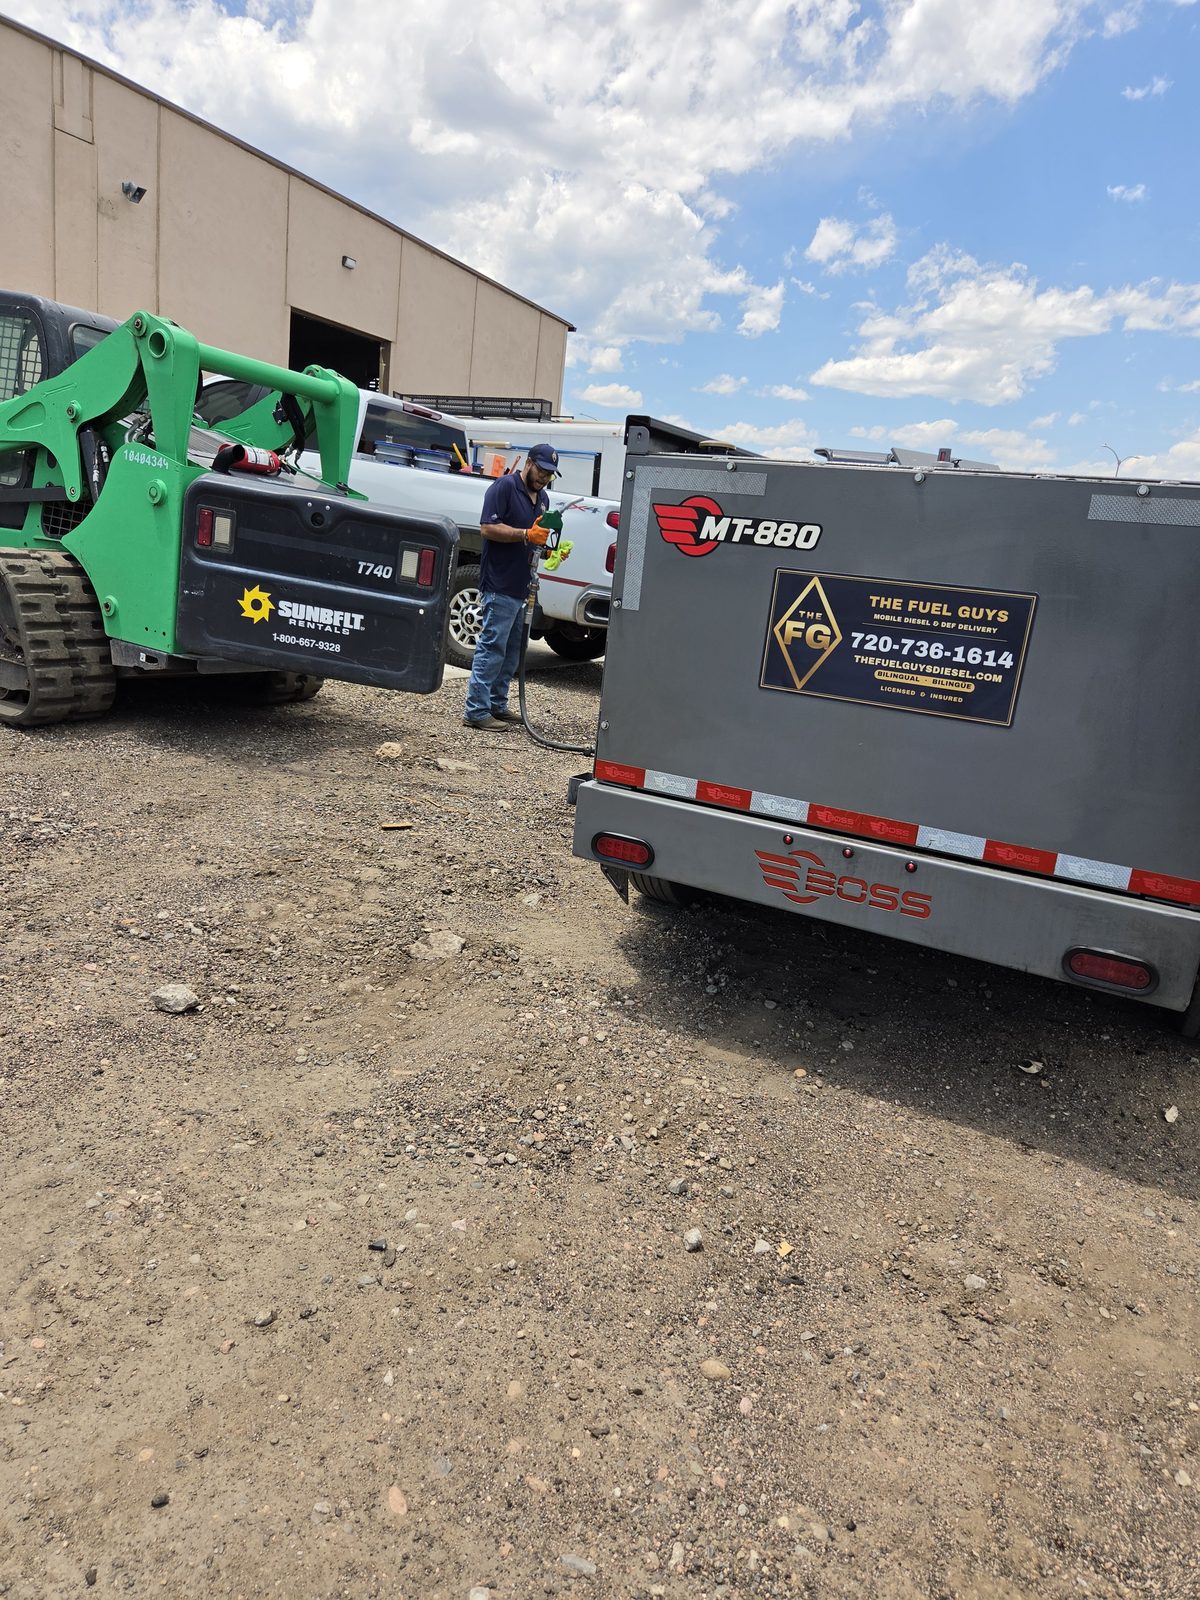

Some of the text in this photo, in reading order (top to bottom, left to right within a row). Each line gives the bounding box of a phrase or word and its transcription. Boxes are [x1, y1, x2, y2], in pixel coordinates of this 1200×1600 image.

[699, 515, 822, 550] MT-880
[357, 561, 393, 579] T740
[798, 610, 823, 620] THE
[869, 595, 1009, 622] THE FUEL GUYS
[288, 618, 350, 636] RENTALS
[873, 613, 903, 623] MOBILE
[903, 616, 931, 626] DIESEL
[940, 621, 956, 629] DEF
[958, 624, 998, 635] DELIVERY
[272, 632, 341, 653] 1-800-667-9328
[783, 620, 832, 651] FG
[851, 631, 1015, 669] 720-736-1614
[854, 654, 1003, 683] THEFUELGUYSDIESEL.COM
[877, 670, 920, 683] BILINGUAL
[880, 685, 916, 696] LICENSED
[929, 693, 964, 703] INSURED
[805, 867, 933, 920] BOSS
